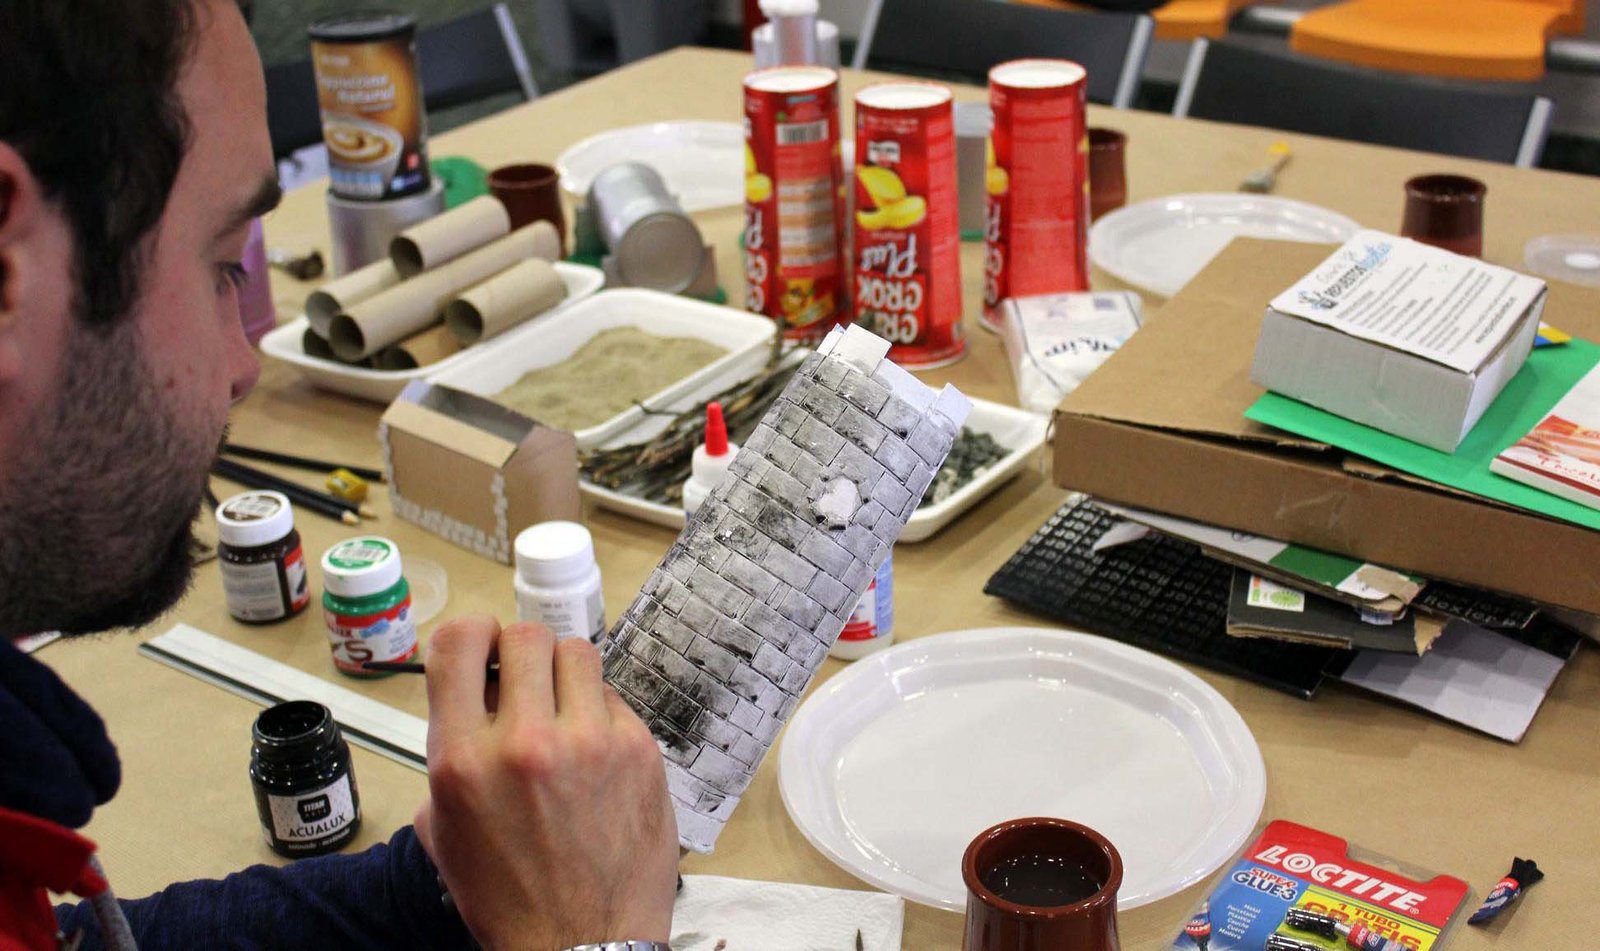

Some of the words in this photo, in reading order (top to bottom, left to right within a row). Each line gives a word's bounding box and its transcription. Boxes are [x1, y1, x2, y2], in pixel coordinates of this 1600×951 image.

[860, 232, 918, 279] Plus
[857, 274, 923, 311] CROK
[288, 812, 346, 838] ACUALUX
[1248, 867, 1297, 888] SUPER
[1253, 844, 1428, 911] LOCTITE
[1337, 902, 1347, 911] 1
[1352, 908, 1401, 930] TUBO
